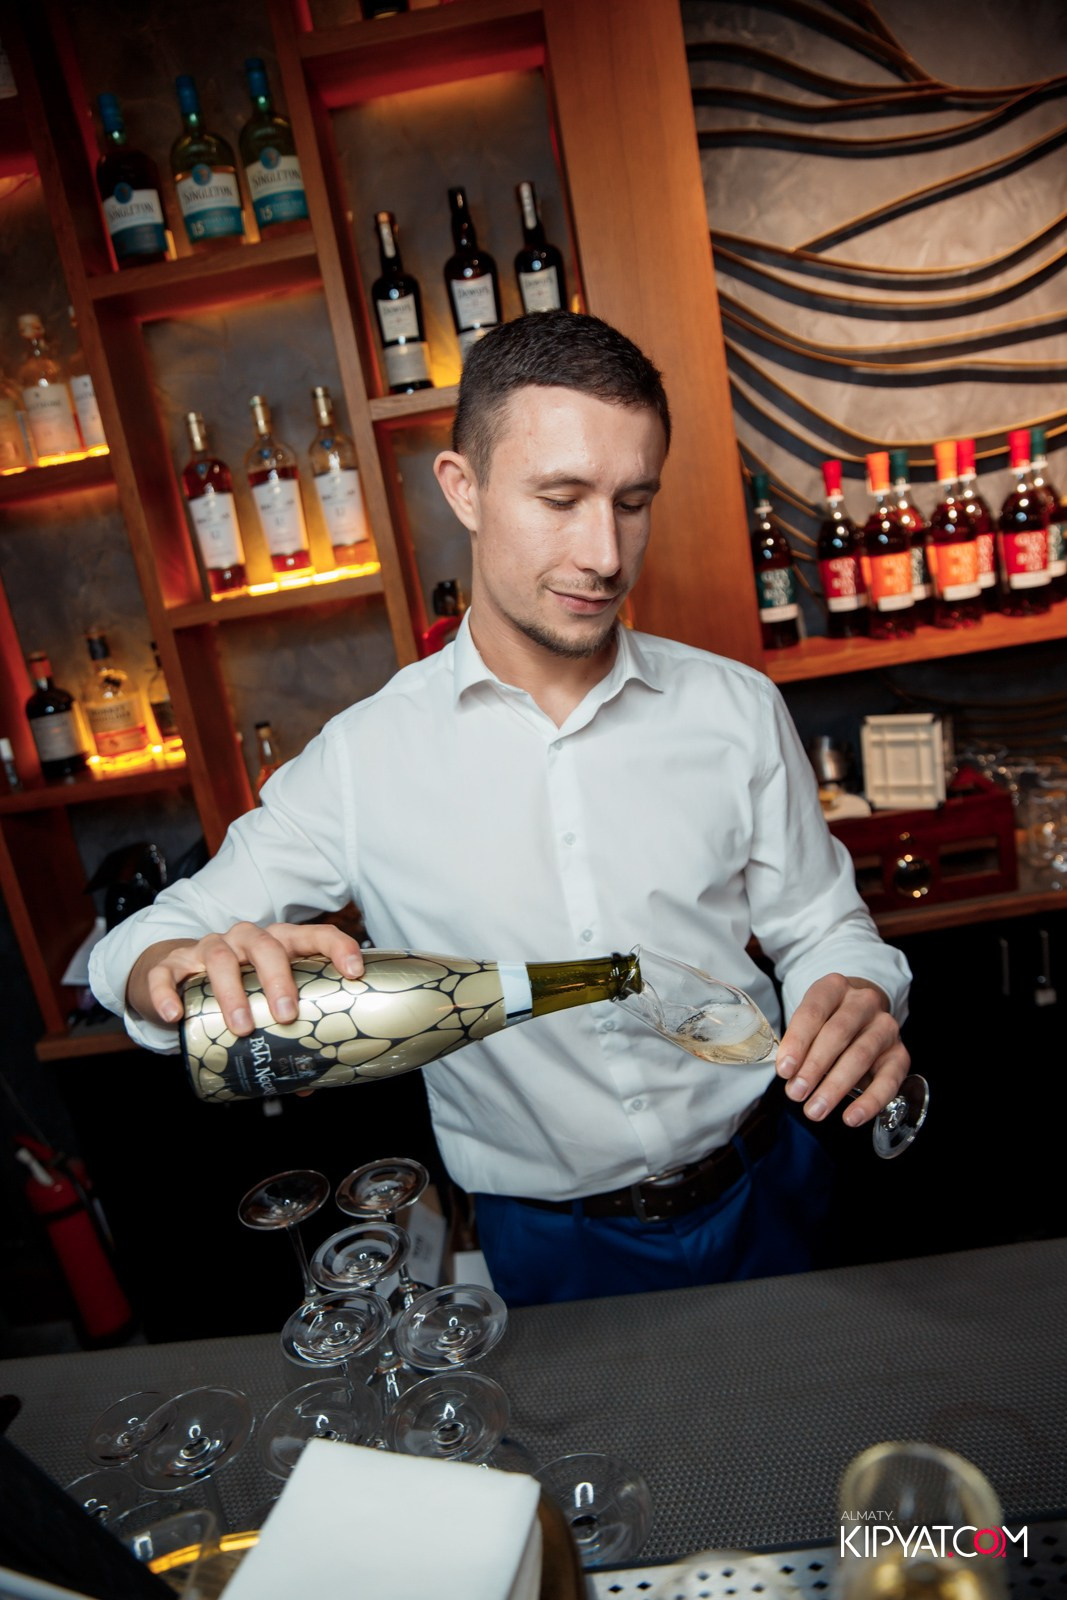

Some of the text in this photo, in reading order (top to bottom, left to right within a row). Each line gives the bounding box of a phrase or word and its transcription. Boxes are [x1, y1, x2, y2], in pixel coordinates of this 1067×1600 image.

[251, 167, 302, 188] SINGLETON
[183, 185, 233, 203] SINGLETON
[109, 201, 154, 219] SINGLETON
[191, 220, 204, 237] 15
[249, 1036, 272, 1066] PATA
